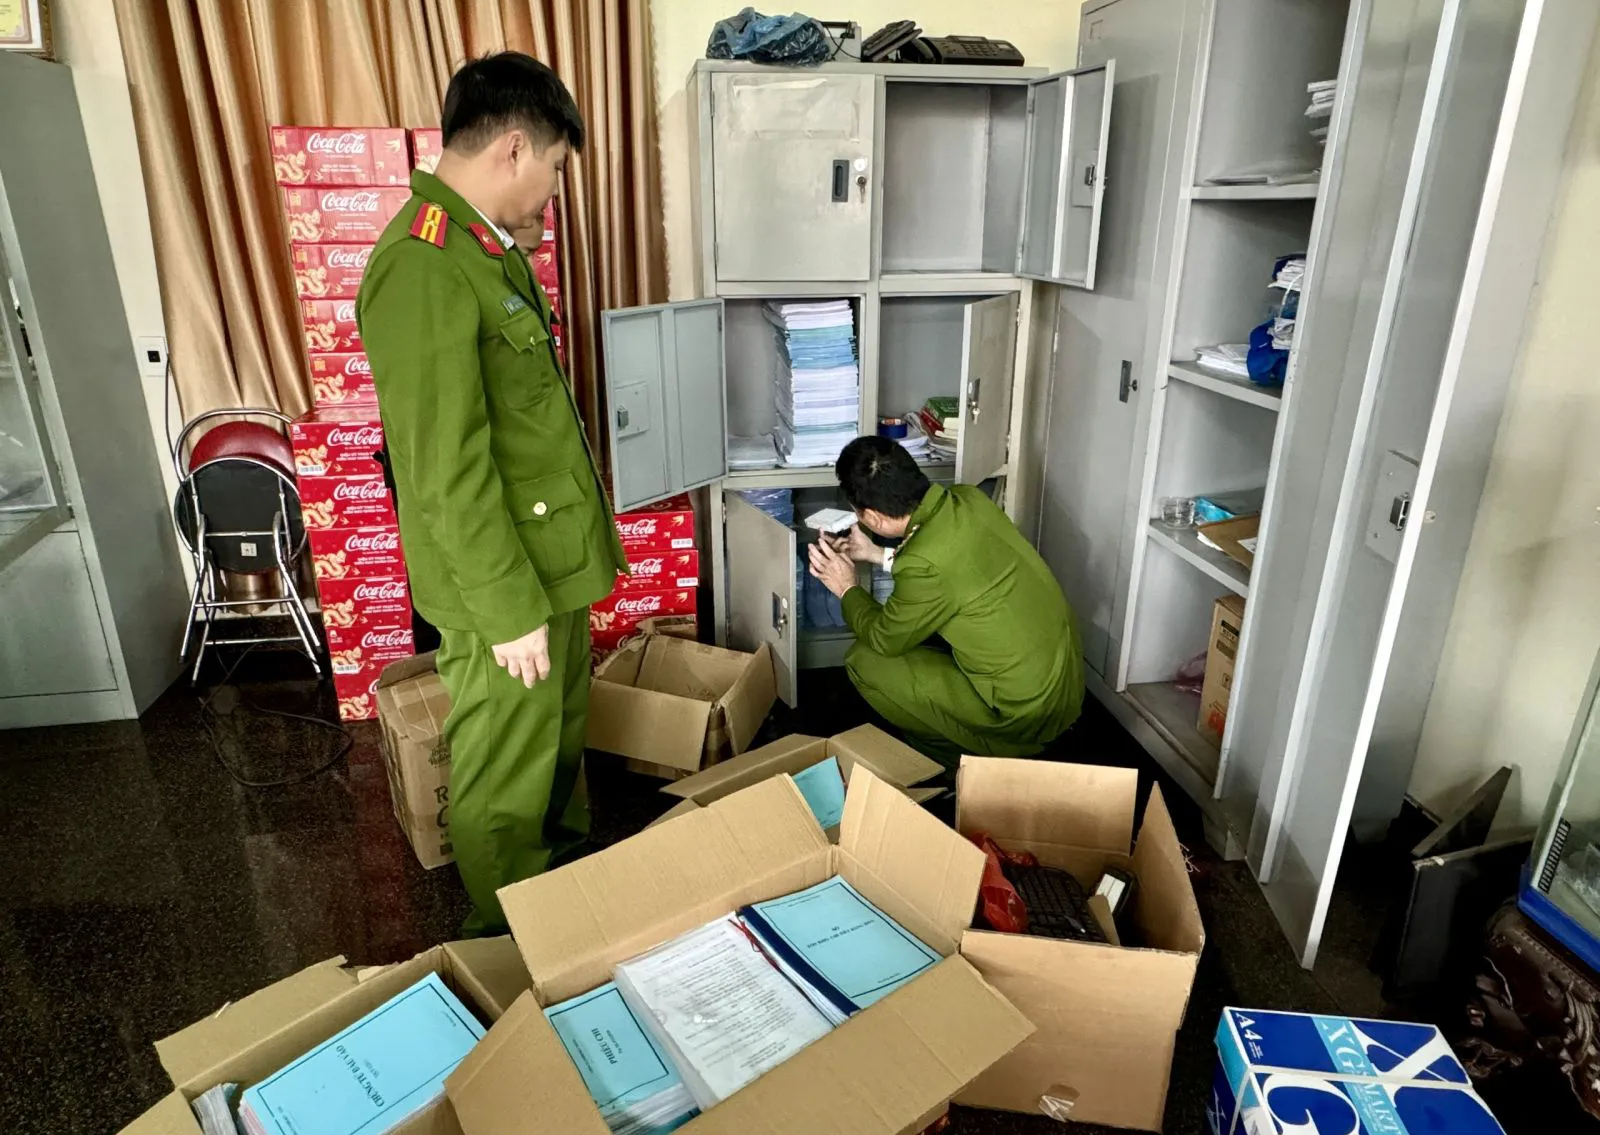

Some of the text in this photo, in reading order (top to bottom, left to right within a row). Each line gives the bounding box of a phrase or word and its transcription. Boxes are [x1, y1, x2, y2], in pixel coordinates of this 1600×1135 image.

[307, 132, 367, 154] Coca-Cola
[321, 191, 381, 212] Coca-Cola
[327, 248, 373, 268] Coca-C
[327, 426, 383, 447] Coca-Cola
[333, 480, 388, 500] Coca-Cola
[615, 518, 659, 535] oca-Cola
[345, 532, 399, 551] Coca-Cola
[354, 581, 407, 601] Coca-Cola
[615, 596, 663, 613] Coca-Cola
[361, 629, 413, 648] Coca-Cola
[1234, 1011, 1263, 1040] A4
